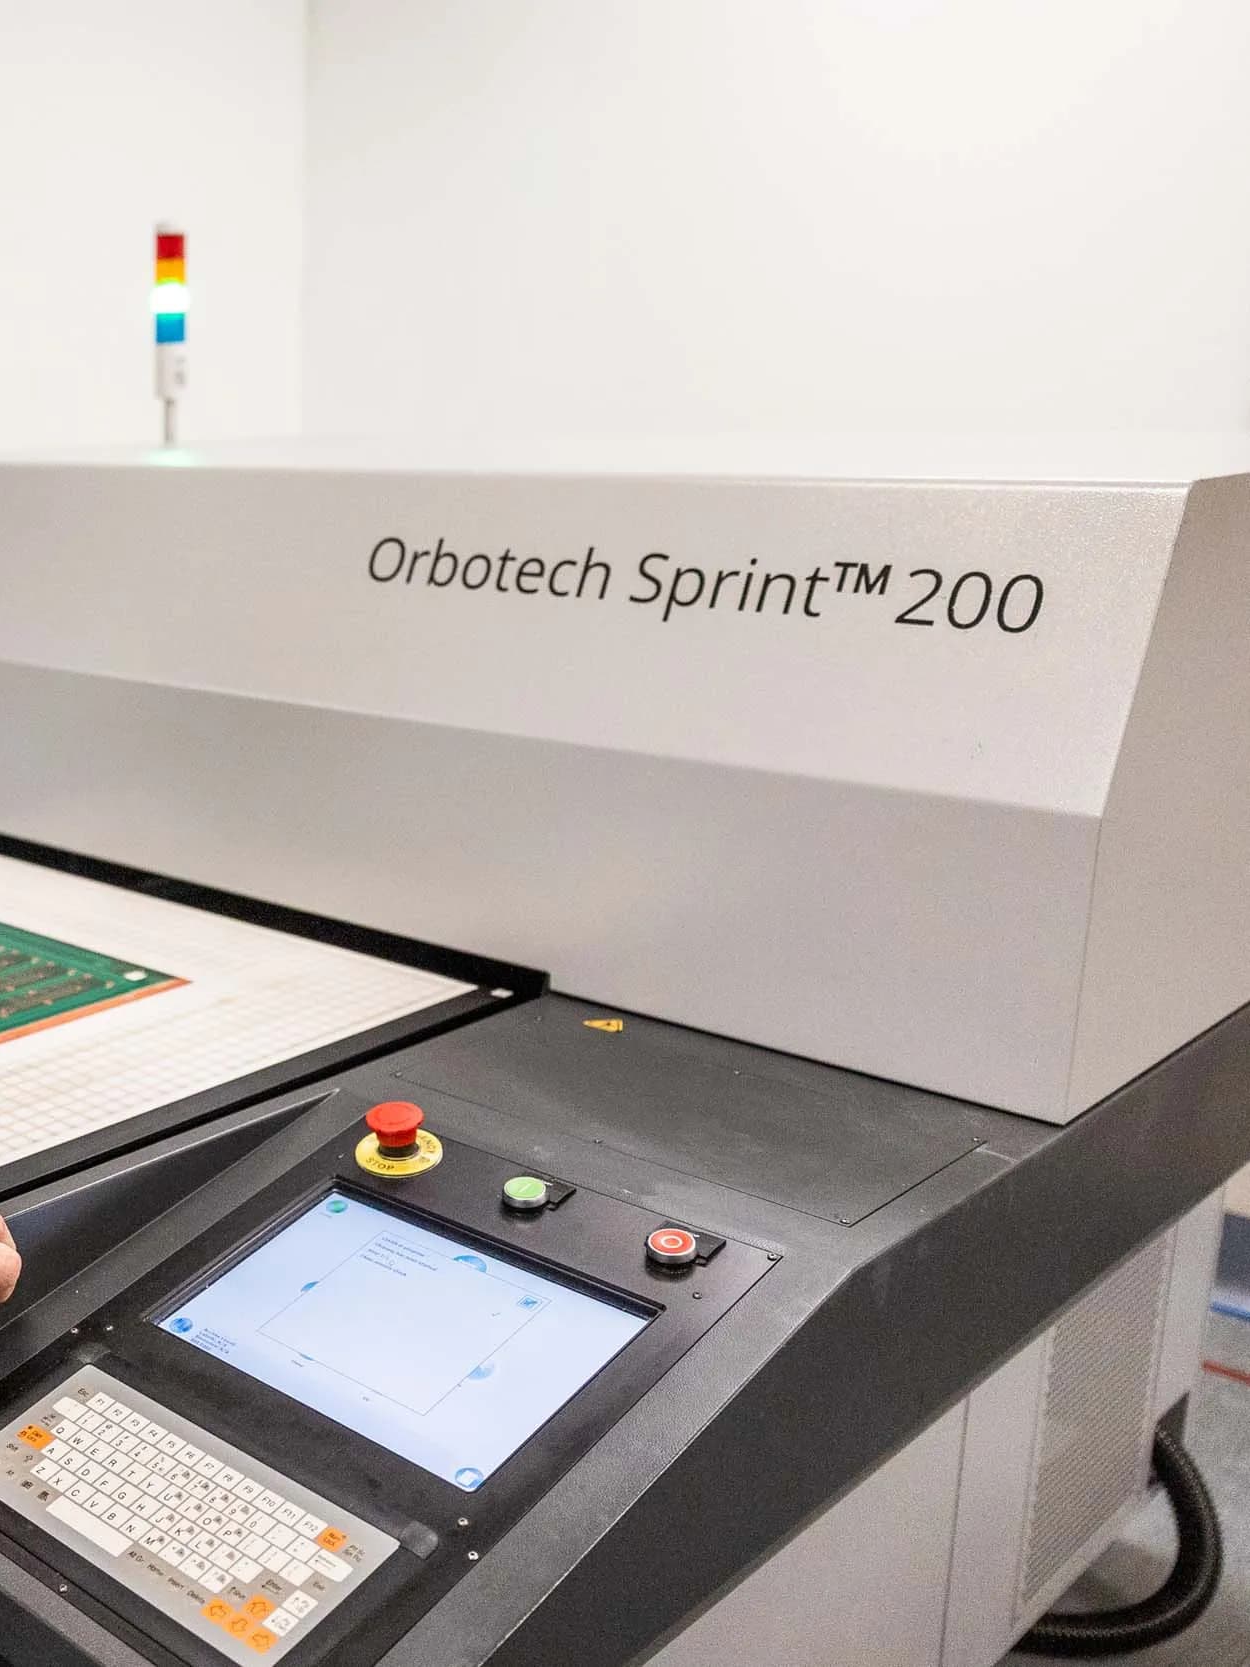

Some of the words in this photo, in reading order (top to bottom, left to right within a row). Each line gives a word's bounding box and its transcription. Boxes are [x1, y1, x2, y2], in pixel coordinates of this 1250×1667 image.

[368, 536, 612, 600] Orbotech
[894, 567, 1044, 634] 200
[366, 1157, 394, 1170] STOP
[262, 1496, 276, 1507] F10
[283, 1508, 296, 1519] F11
[304, 1521, 319, 1532] F12
